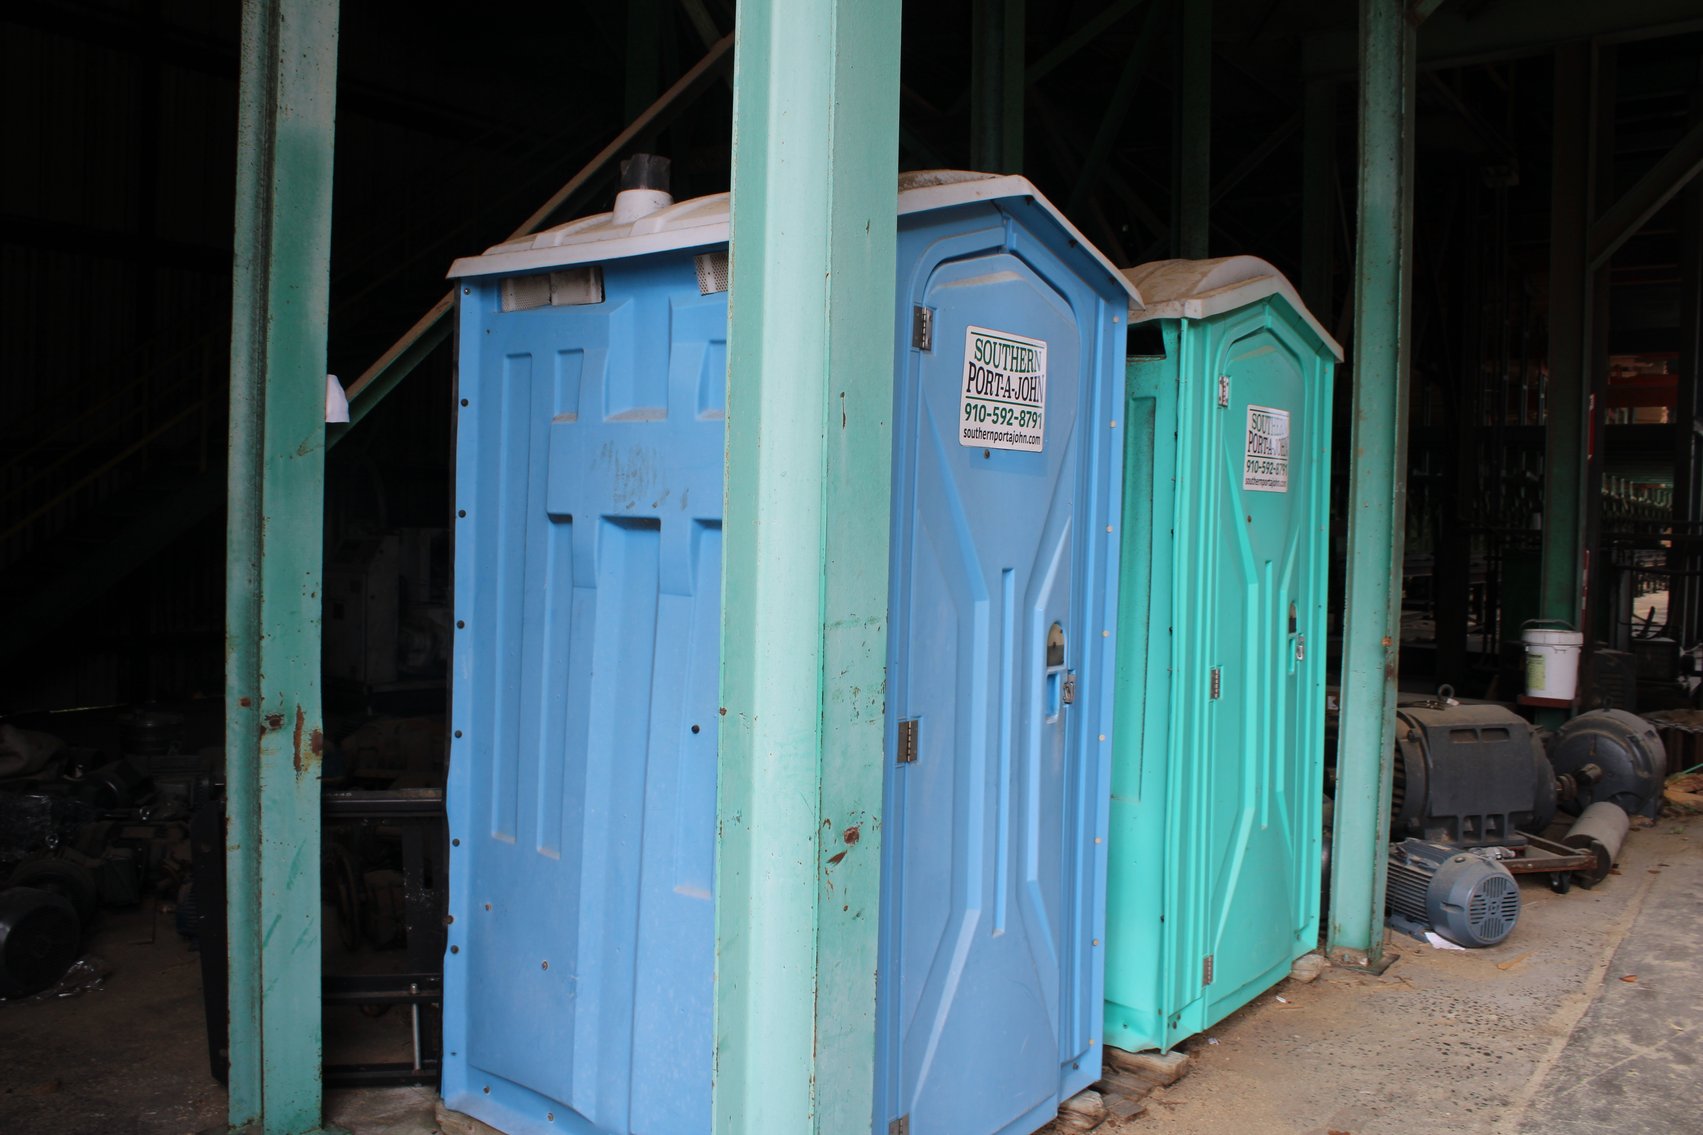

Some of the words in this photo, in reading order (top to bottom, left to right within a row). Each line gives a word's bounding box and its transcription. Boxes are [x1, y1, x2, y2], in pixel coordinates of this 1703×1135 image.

[974, 338, 1042, 373] SOUTHERN
[966, 361, 1044, 403] PORT-A-JOHN
[965, 402, 1042, 430] 910-592-8791
[963, 426, 1041, 446] southernportajohn.com
